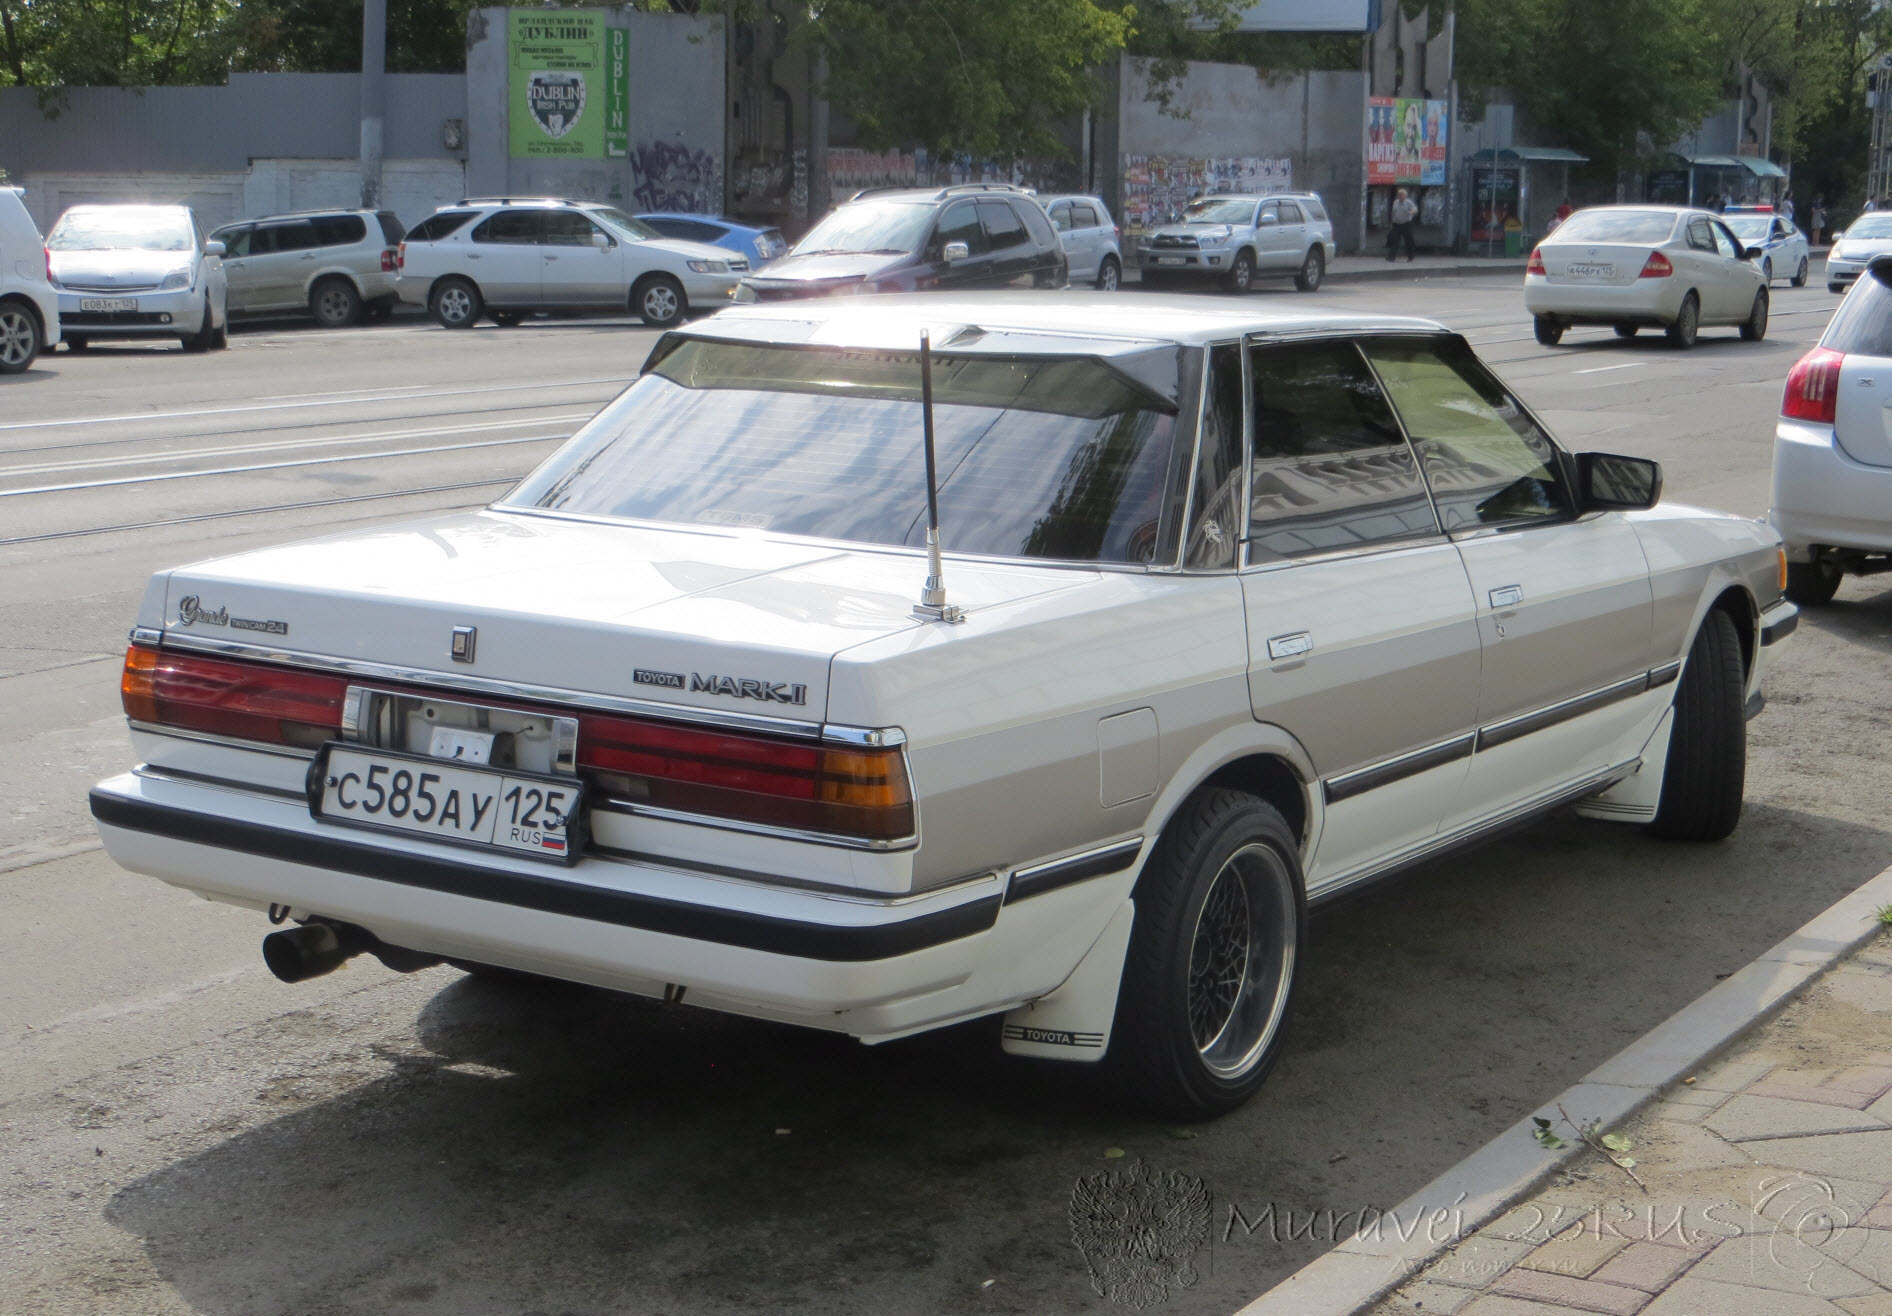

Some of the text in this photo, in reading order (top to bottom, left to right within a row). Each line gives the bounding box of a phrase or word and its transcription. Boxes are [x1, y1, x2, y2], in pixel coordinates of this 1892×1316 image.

[613, 30, 624, 128] DUBLIN
[533, 86, 580, 100] DUBLIN
[635, 671, 681, 687] TOYOTA
[690, 672, 787, 703] MARK
[505, 785, 565, 831] 125
[510, 827, 542, 846] RUS
[1026, 1030, 1071, 1044] TOYOTA
